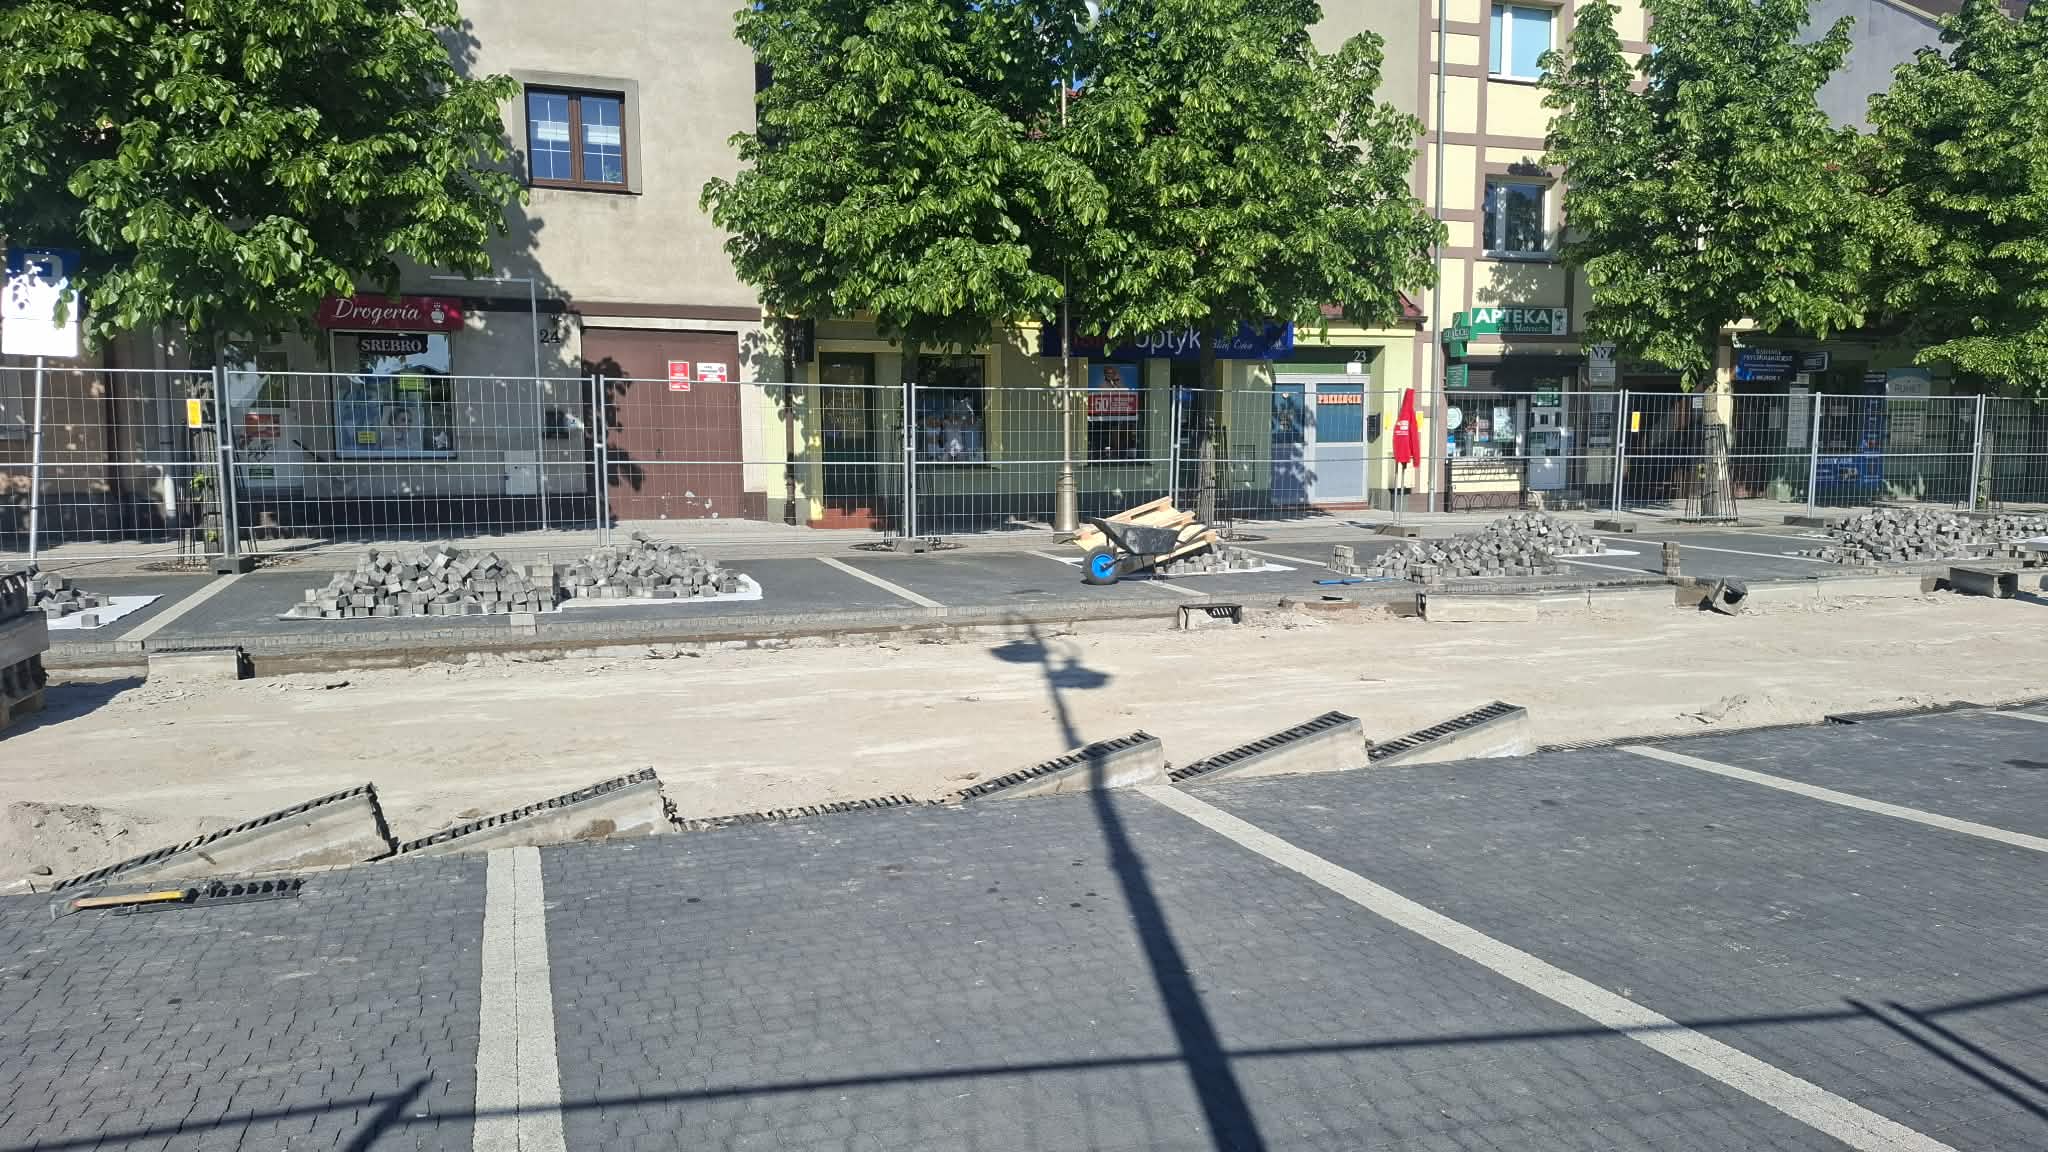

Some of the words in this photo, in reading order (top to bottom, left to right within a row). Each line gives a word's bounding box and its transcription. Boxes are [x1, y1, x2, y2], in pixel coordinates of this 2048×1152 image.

[1474, 309, 1550, 324] APTEKA
[540, 329, 560, 344] 24
[361, 339, 422, 352] SREBRO
[1352, 350, 1367, 362] 23
